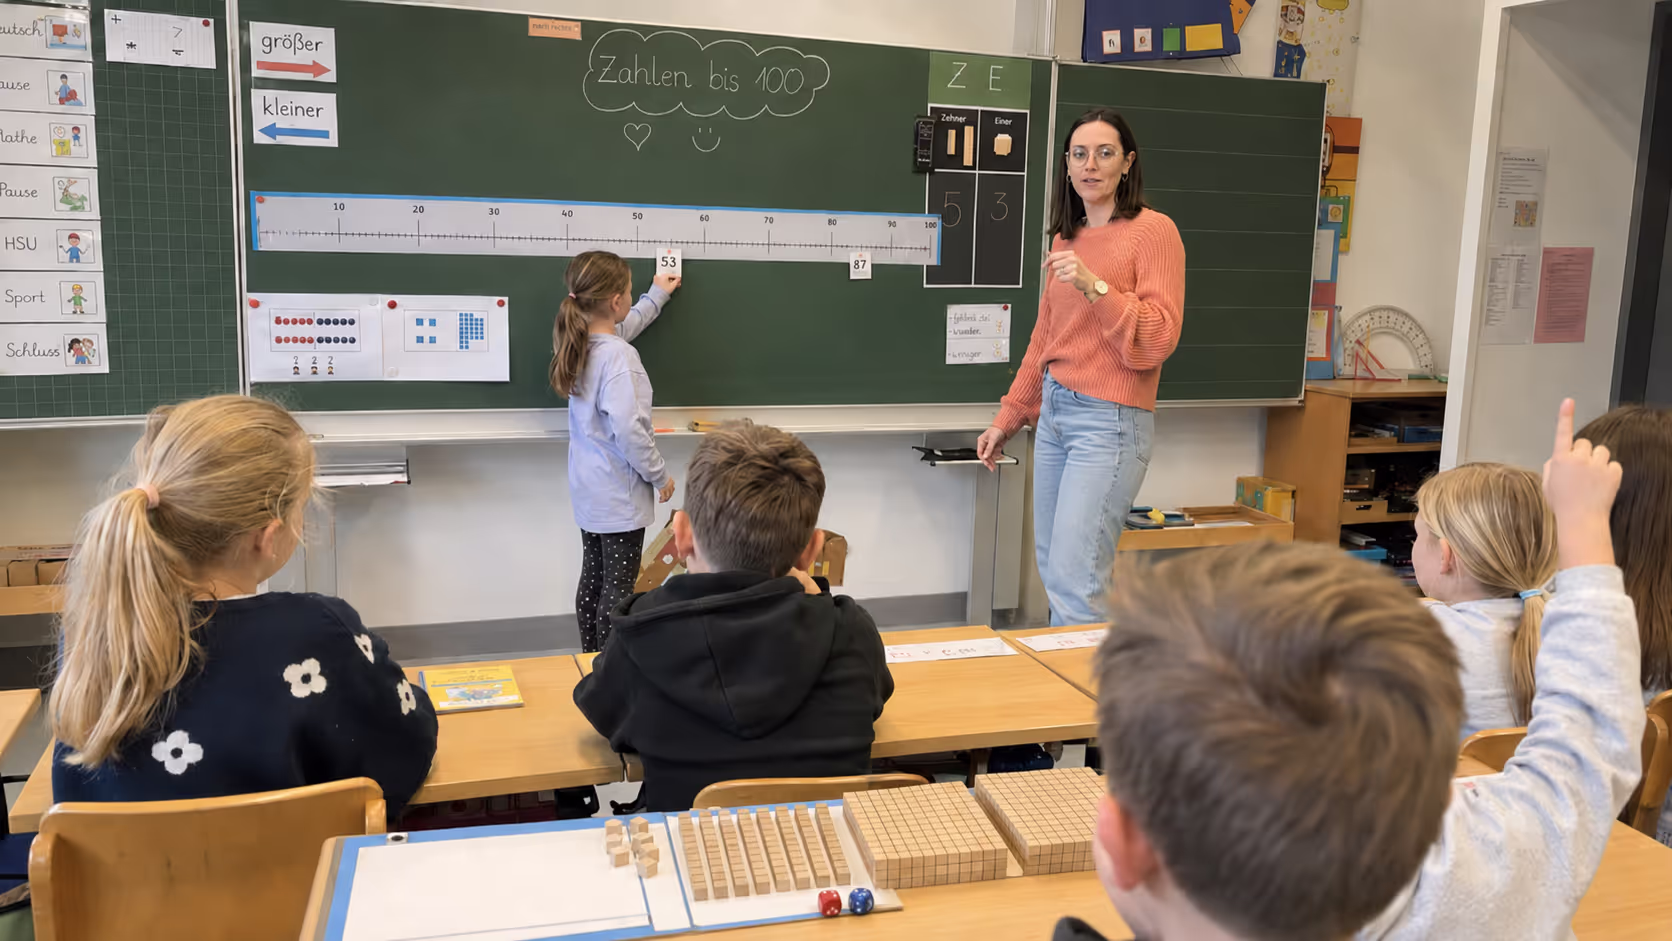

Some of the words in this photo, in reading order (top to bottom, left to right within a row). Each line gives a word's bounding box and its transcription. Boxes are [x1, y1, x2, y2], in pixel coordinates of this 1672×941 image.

[0, 19, 43, 37] eutsch
[262, 33, 323, 55] größer
[598, 54, 692, 88] Zahlen
[710, 60, 739, 92] bis
[755, 67, 804, 94] 100
[948, 62, 967, 88] Z
[989, 65, 1003, 91] E
[0, 81, 30, 90] ause
[263, 95, 324, 118] kleiner
[941, 113, 967, 123] Zehner
[994, 116, 1013, 126] Einer
[0, 182, 37, 197] Pause
[943, 192, 961, 227] 5
[991, 192, 1008, 220] 3
[333, 202, 346, 211] 10
[412, 205, 425, 214] 20
[488, 207, 500, 216] 30
[561, 209, 574, 218] 40
[632, 212, 644, 221] 50
[699, 213, 710, 222] 60
[763, 215, 774, 225] 70
[827, 217, 838, 226] 80
[887, 220, 897, 228] 90
[925, 220, 938, 229] 100
[5, 236, 36, 250] HSU
[660, 256, 677, 268] 53
[853, 259, 867, 270] 87
[5, 289, 45, 308] Sport
[6, 342, 60, 357] Schluss
